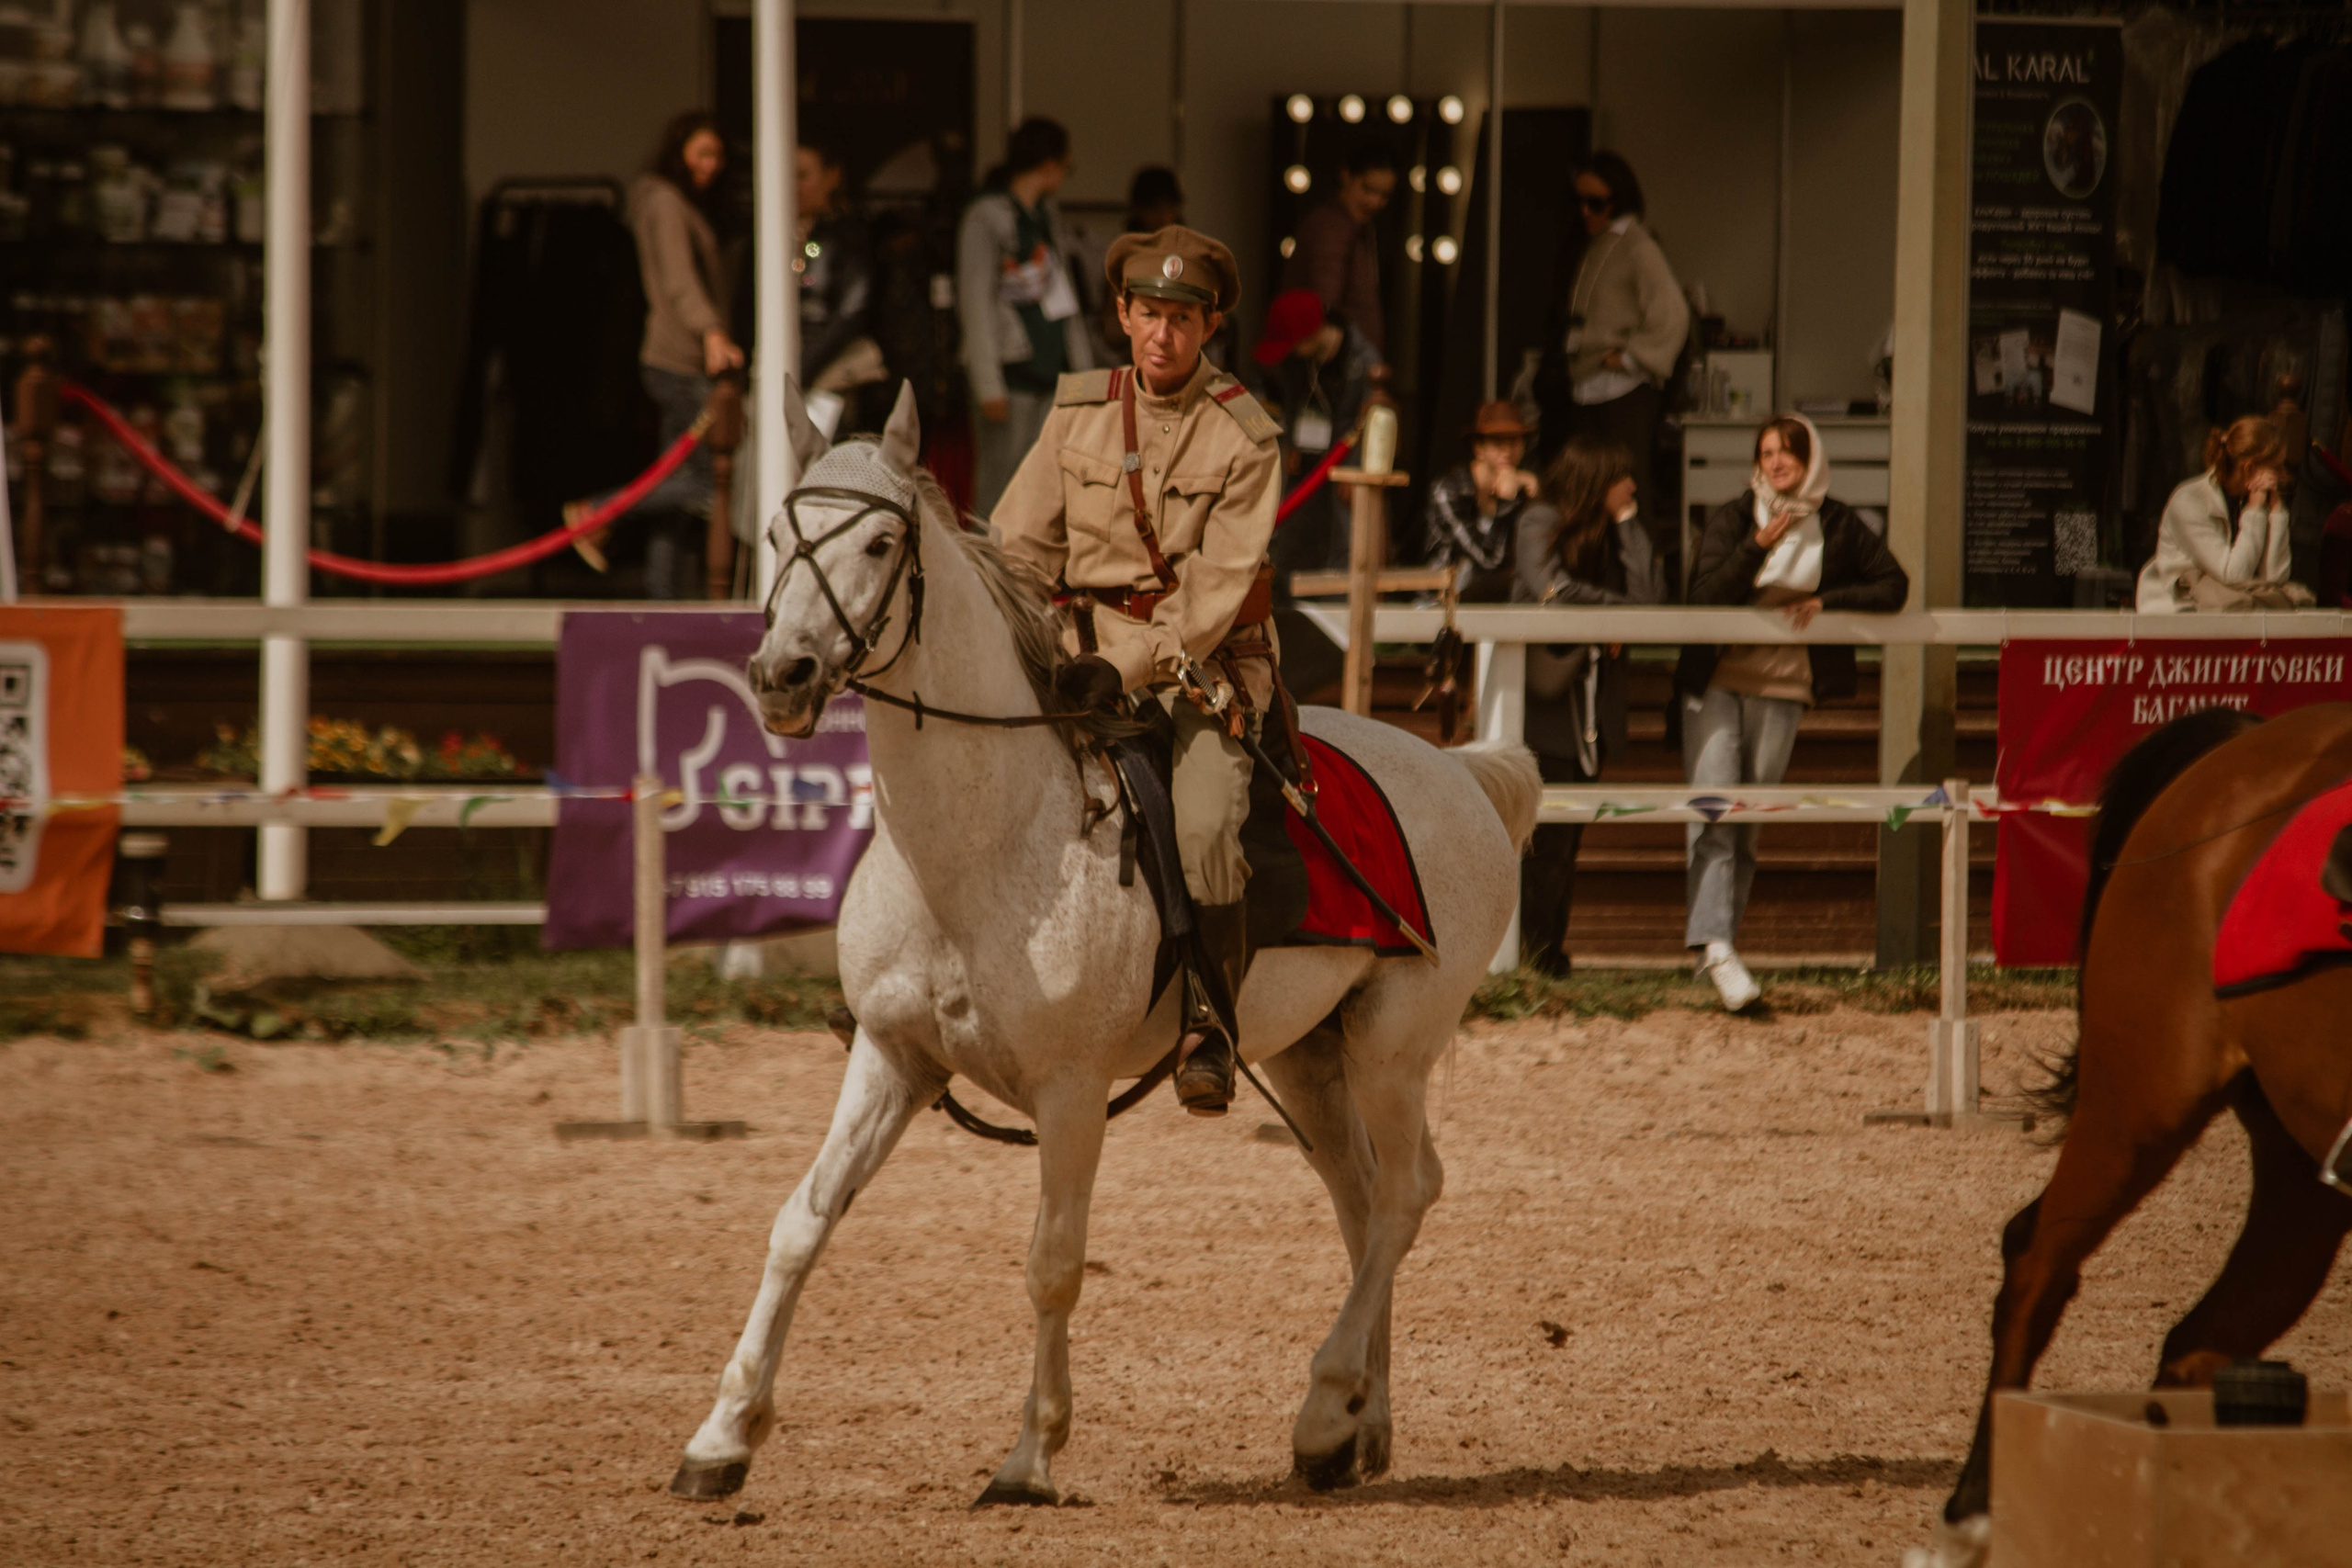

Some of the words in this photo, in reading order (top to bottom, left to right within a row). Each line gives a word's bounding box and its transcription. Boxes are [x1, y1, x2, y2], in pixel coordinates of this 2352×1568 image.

[2007, 53, 2090, 84] KARAL
[2041, 653, 2144, 693] ЦЕНТР
[2147, 652, 2345, 690] ДЖИГИТОВКИ
